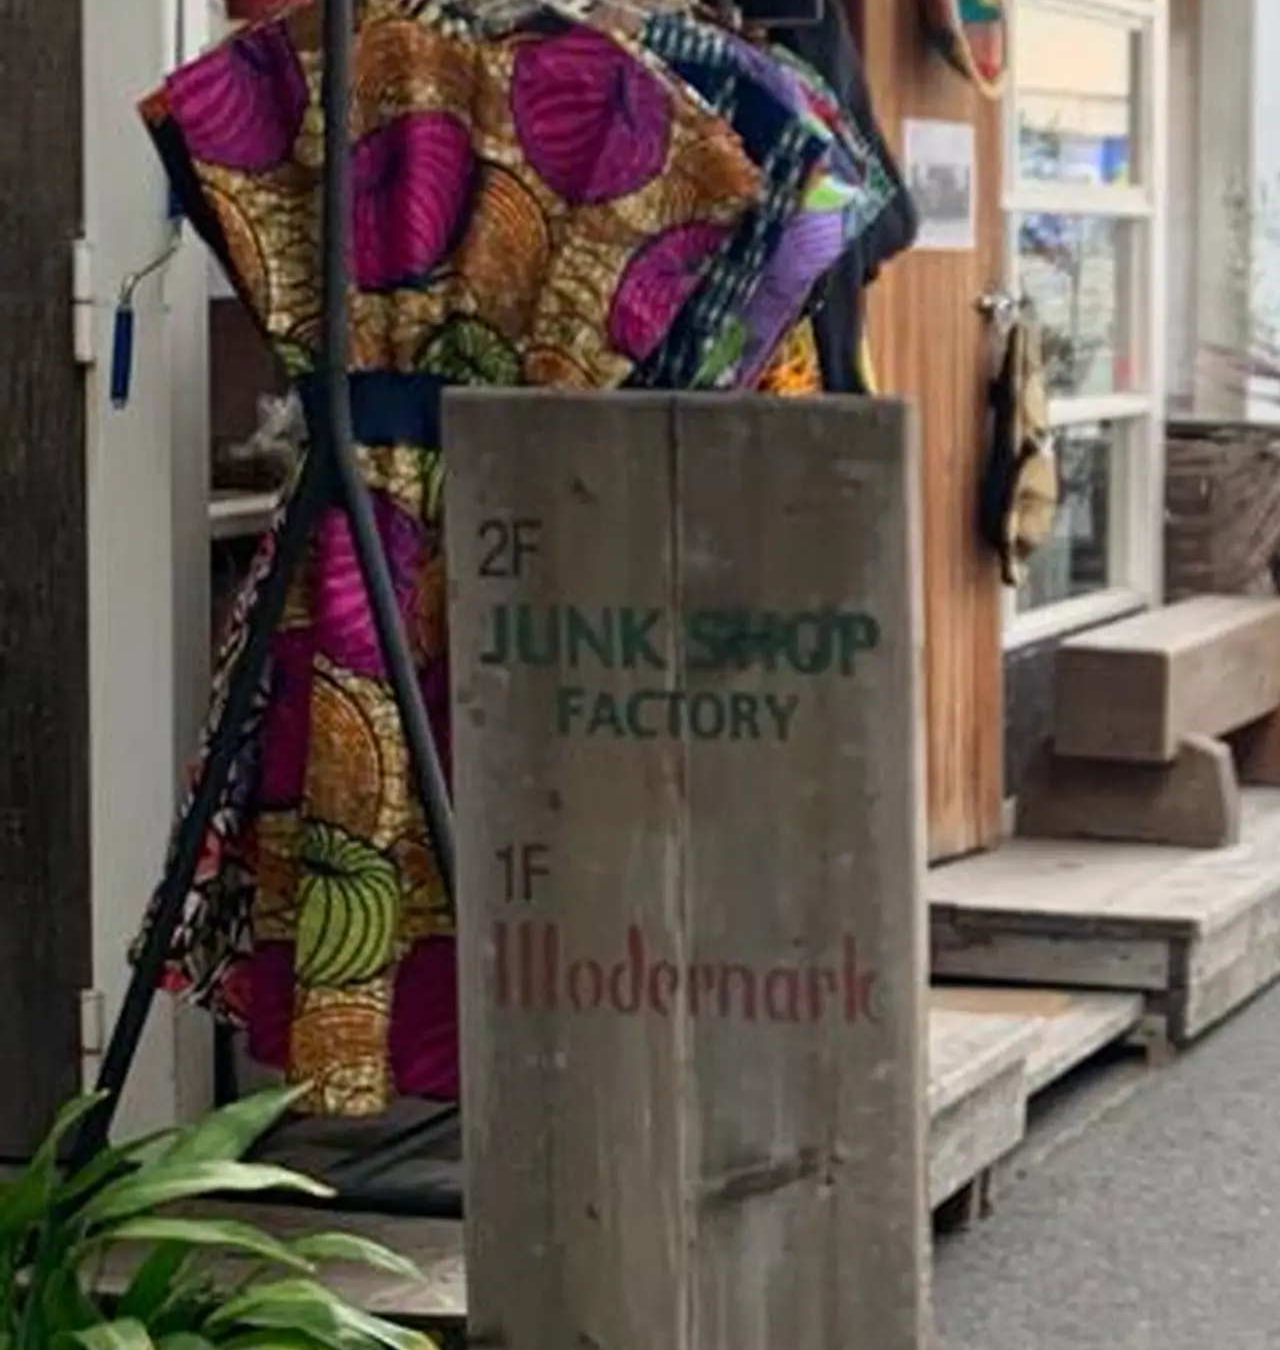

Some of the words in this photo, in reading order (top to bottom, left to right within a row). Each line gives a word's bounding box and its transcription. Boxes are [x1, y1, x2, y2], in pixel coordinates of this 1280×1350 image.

[477, 519, 543, 578] 2F
[478, 604, 670, 672] JUNK
[684, 606, 882, 679] SHOP
[555, 686, 799, 742] FACTORY
[496, 844, 551, 905] 1F
[493, 920, 884, 1025] Modernark
